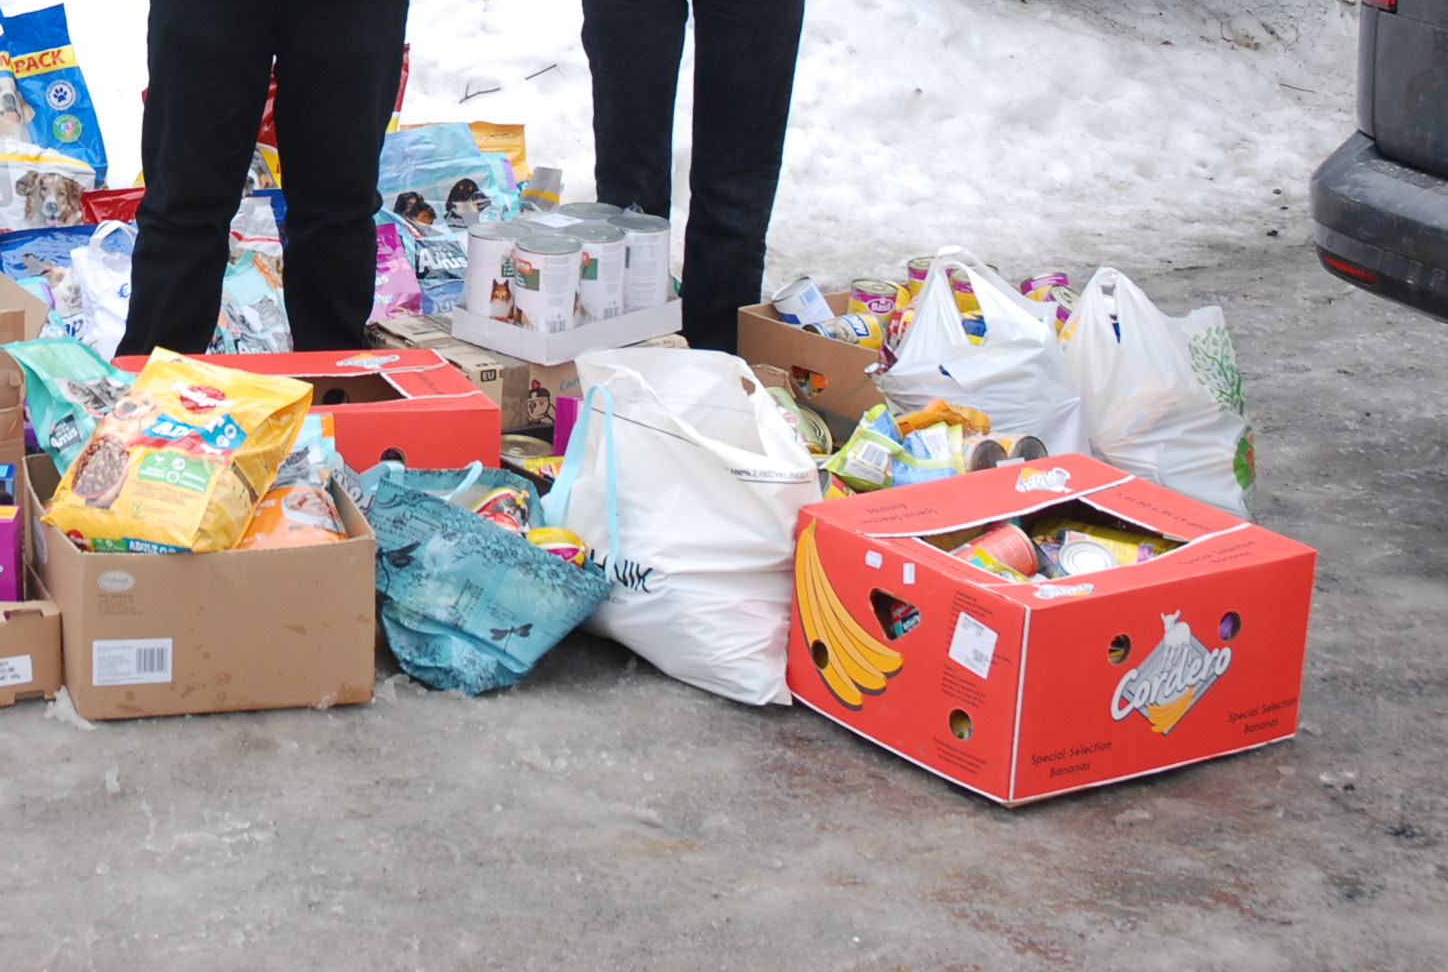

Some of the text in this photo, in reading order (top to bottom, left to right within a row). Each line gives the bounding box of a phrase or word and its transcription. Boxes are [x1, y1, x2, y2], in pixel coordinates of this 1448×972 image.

[13, 49, 66, 74] PACK
[1110, 644, 1232, 722] Cordero
[1228, 697, 1298, 724] Special Selection
[1244, 719, 1280, 734] Bananas
[1031, 741, 1113, 767] Special Selection
[1049, 763, 1091, 777] Bananas
